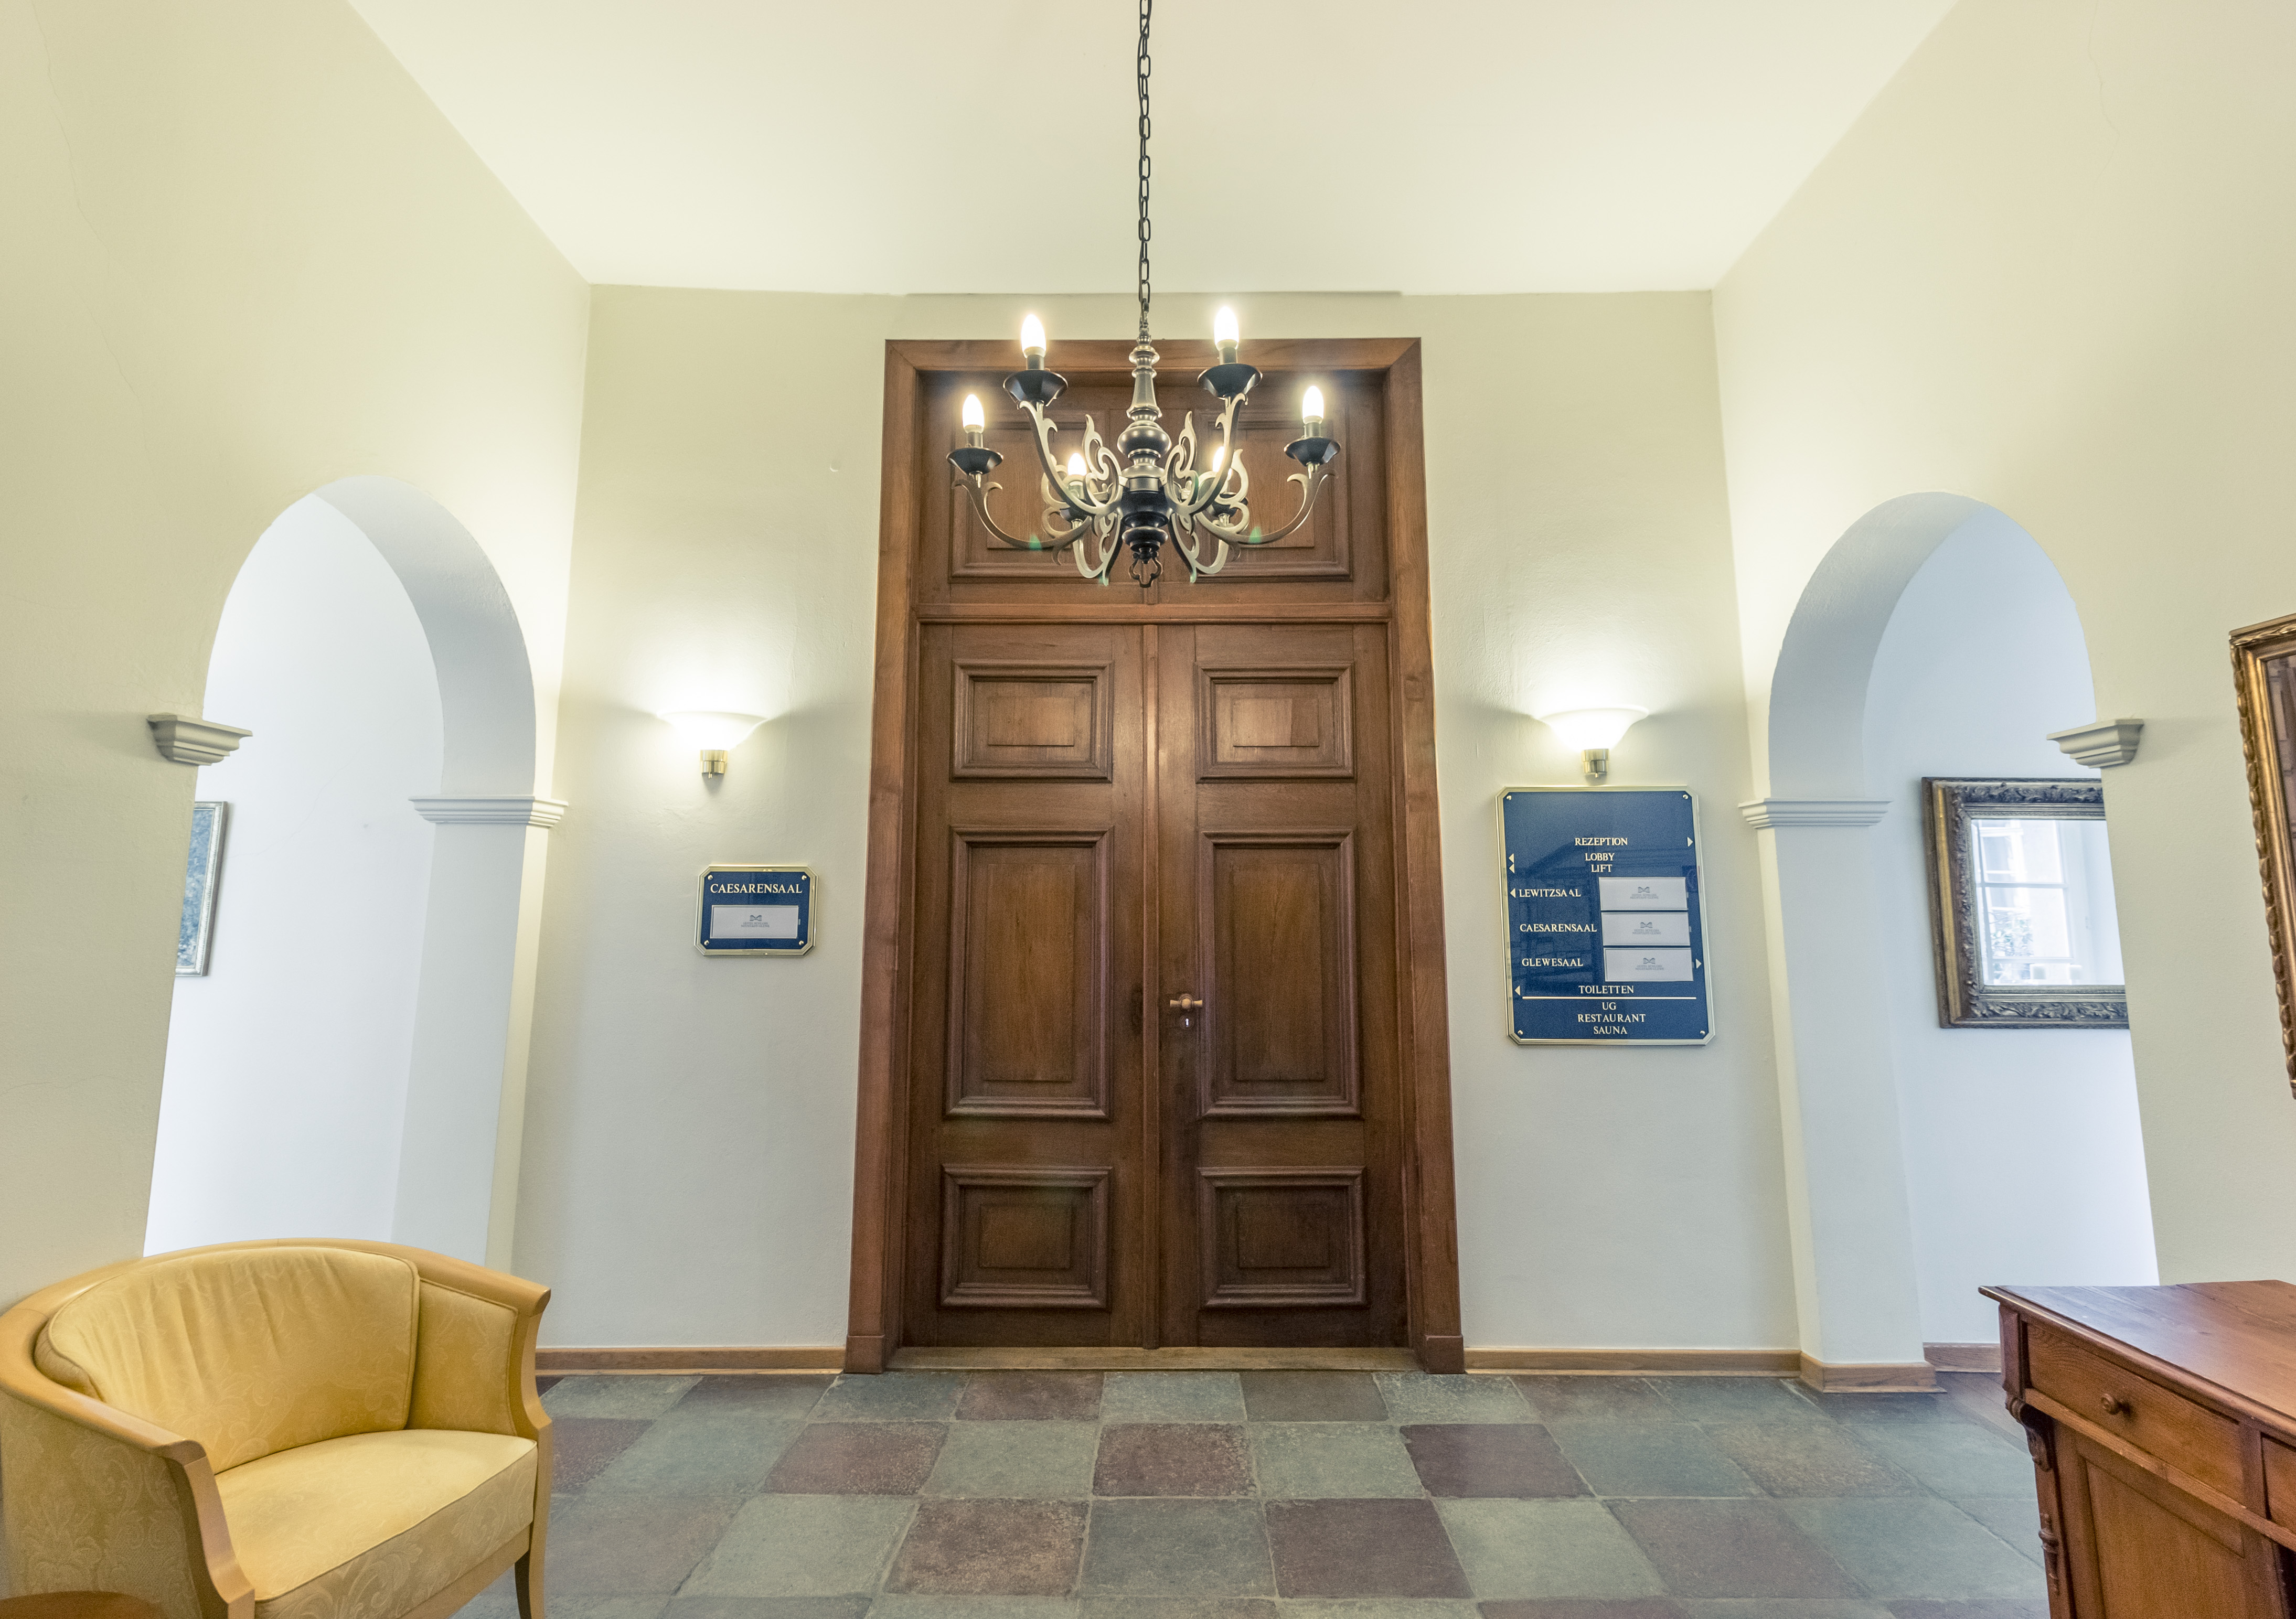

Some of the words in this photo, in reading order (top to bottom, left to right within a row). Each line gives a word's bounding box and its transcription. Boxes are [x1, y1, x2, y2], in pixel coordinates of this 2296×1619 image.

[1574, 837, 1628, 846] REZEPTION
[1585, 853, 1615, 862] LOBBY
[1591, 864, 1612, 873] LIFT
[710, 883, 803, 894] CAESARENSAAL
[1519, 888, 1582, 898] LEWITZSAAL
[1519, 924, 1597, 932] CAESARENSAAL
[1521, 958, 1584, 967] GLEWESAAL
[1578, 985, 1635, 994] TOILETTEN
[1601, 1002, 1617, 1011] UG
[1577, 1014, 1646, 1023] RESTAURANT
[1593, 1026, 1628, 1035] SAUNA
